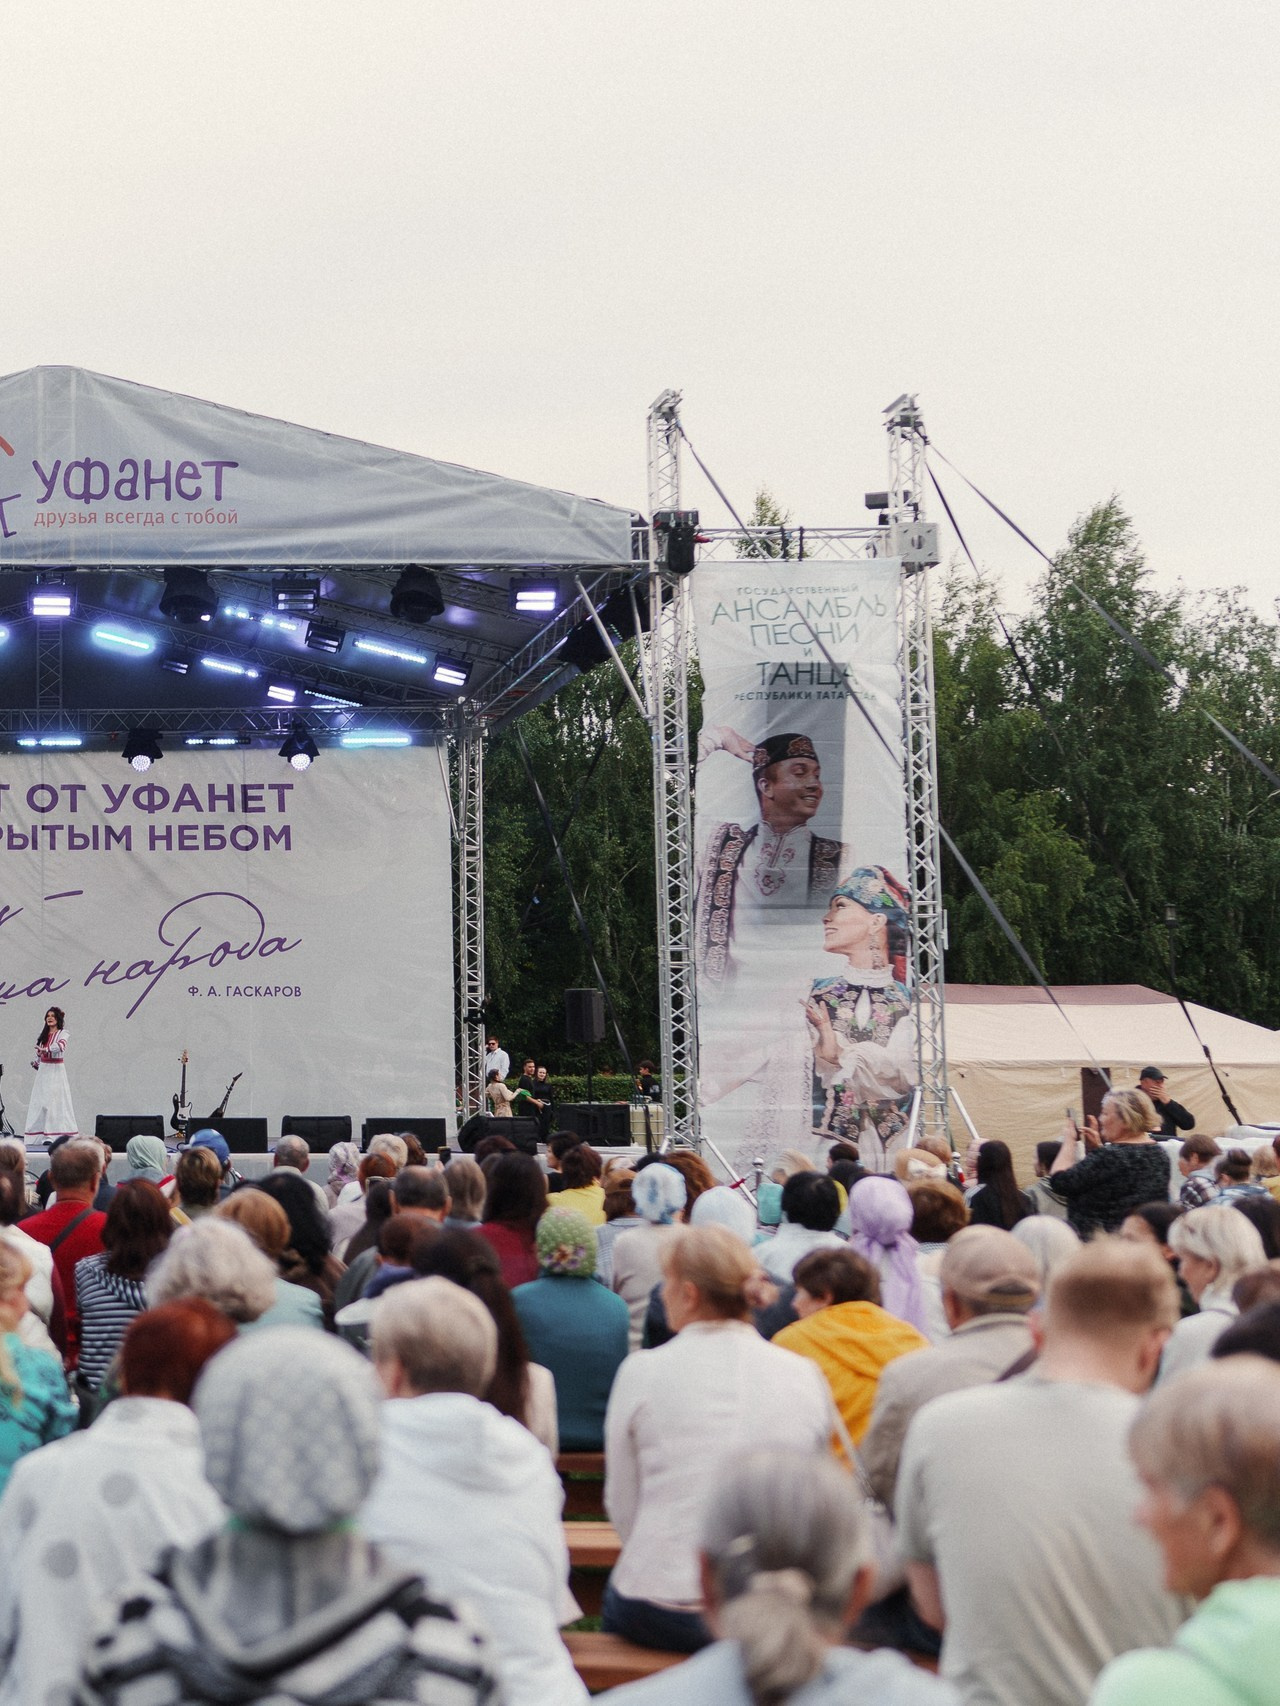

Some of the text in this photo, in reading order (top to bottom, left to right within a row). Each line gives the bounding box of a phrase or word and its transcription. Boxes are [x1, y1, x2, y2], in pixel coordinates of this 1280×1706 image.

[34, 508, 239, 528] друзья всегда с тобой
[736, 583, 859, 596] ГОСУДАРСТВЕННЫЙ
[711, 594, 887, 625] АНСАМБЛЬ
[750, 622, 859, 647] ПЕСНИ
[734, 690, 813, 701] РЕСПУБЛИКИ
[26, 783, 86, 813] ОТ
[103, 783, 294, 814] УФАНЕТ
[148, 824, 292, 852] НЕБОМ
[187, 984, 302, 998] Ф. А. ГАСКАРОВ
